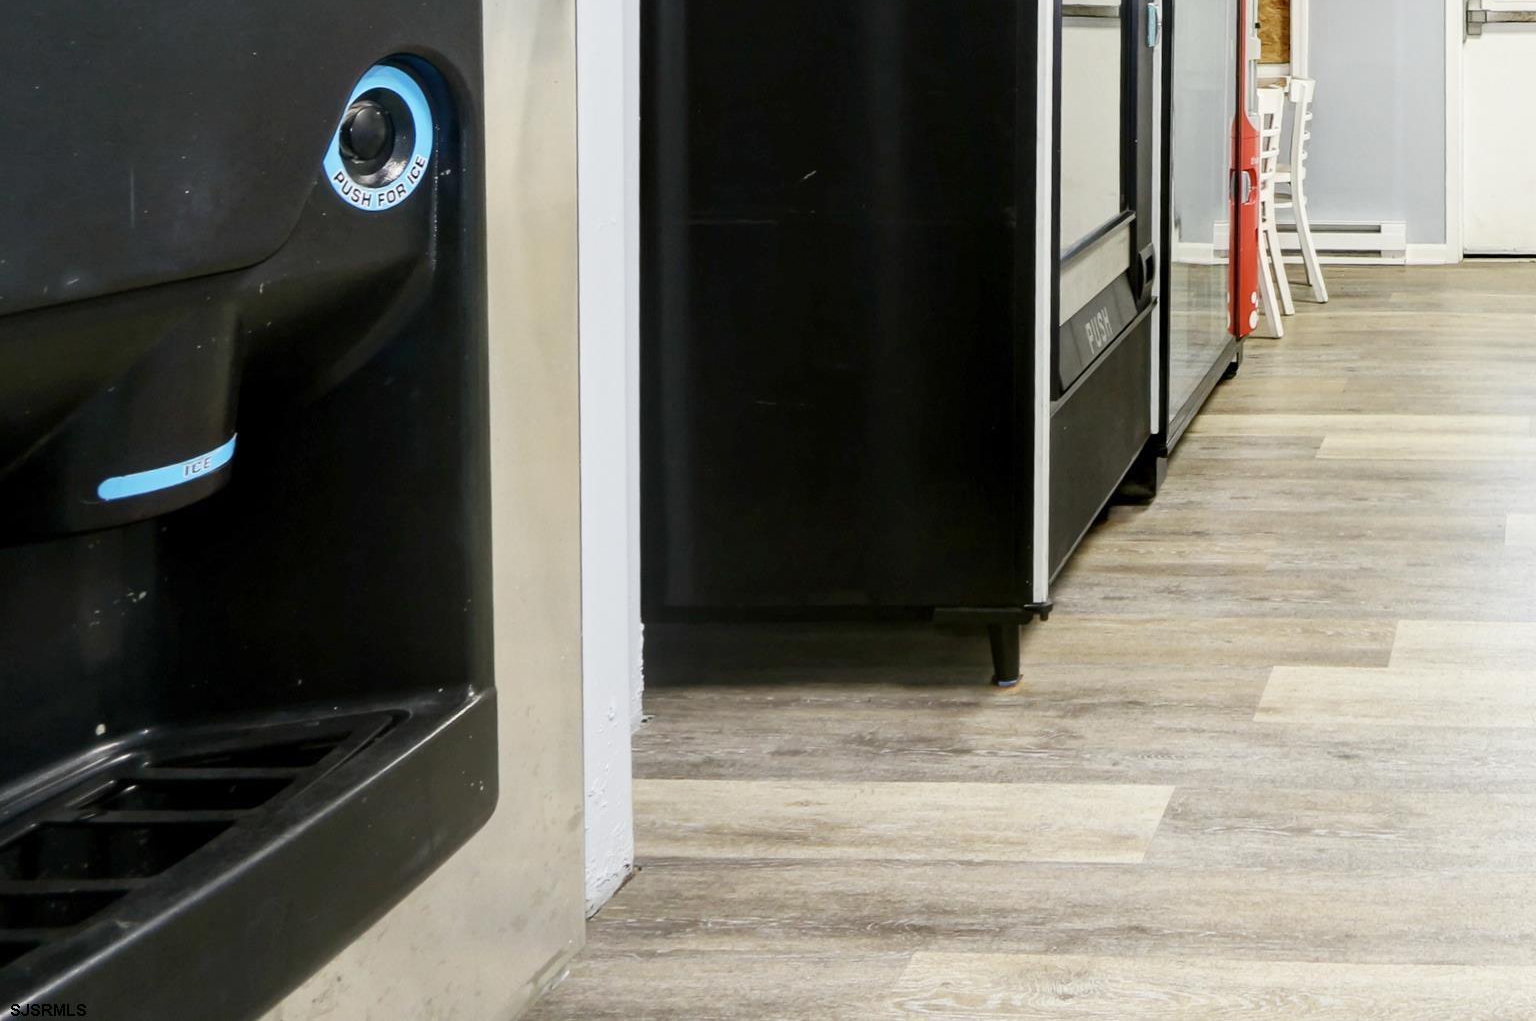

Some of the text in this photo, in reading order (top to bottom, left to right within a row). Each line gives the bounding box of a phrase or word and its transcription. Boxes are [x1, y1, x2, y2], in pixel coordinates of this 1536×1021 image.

[333, 156, 427, 207] PUSH FOR ICE
[1085, 306, 1114, 355] PUSH
[184, 457, 212, 477] ICE
